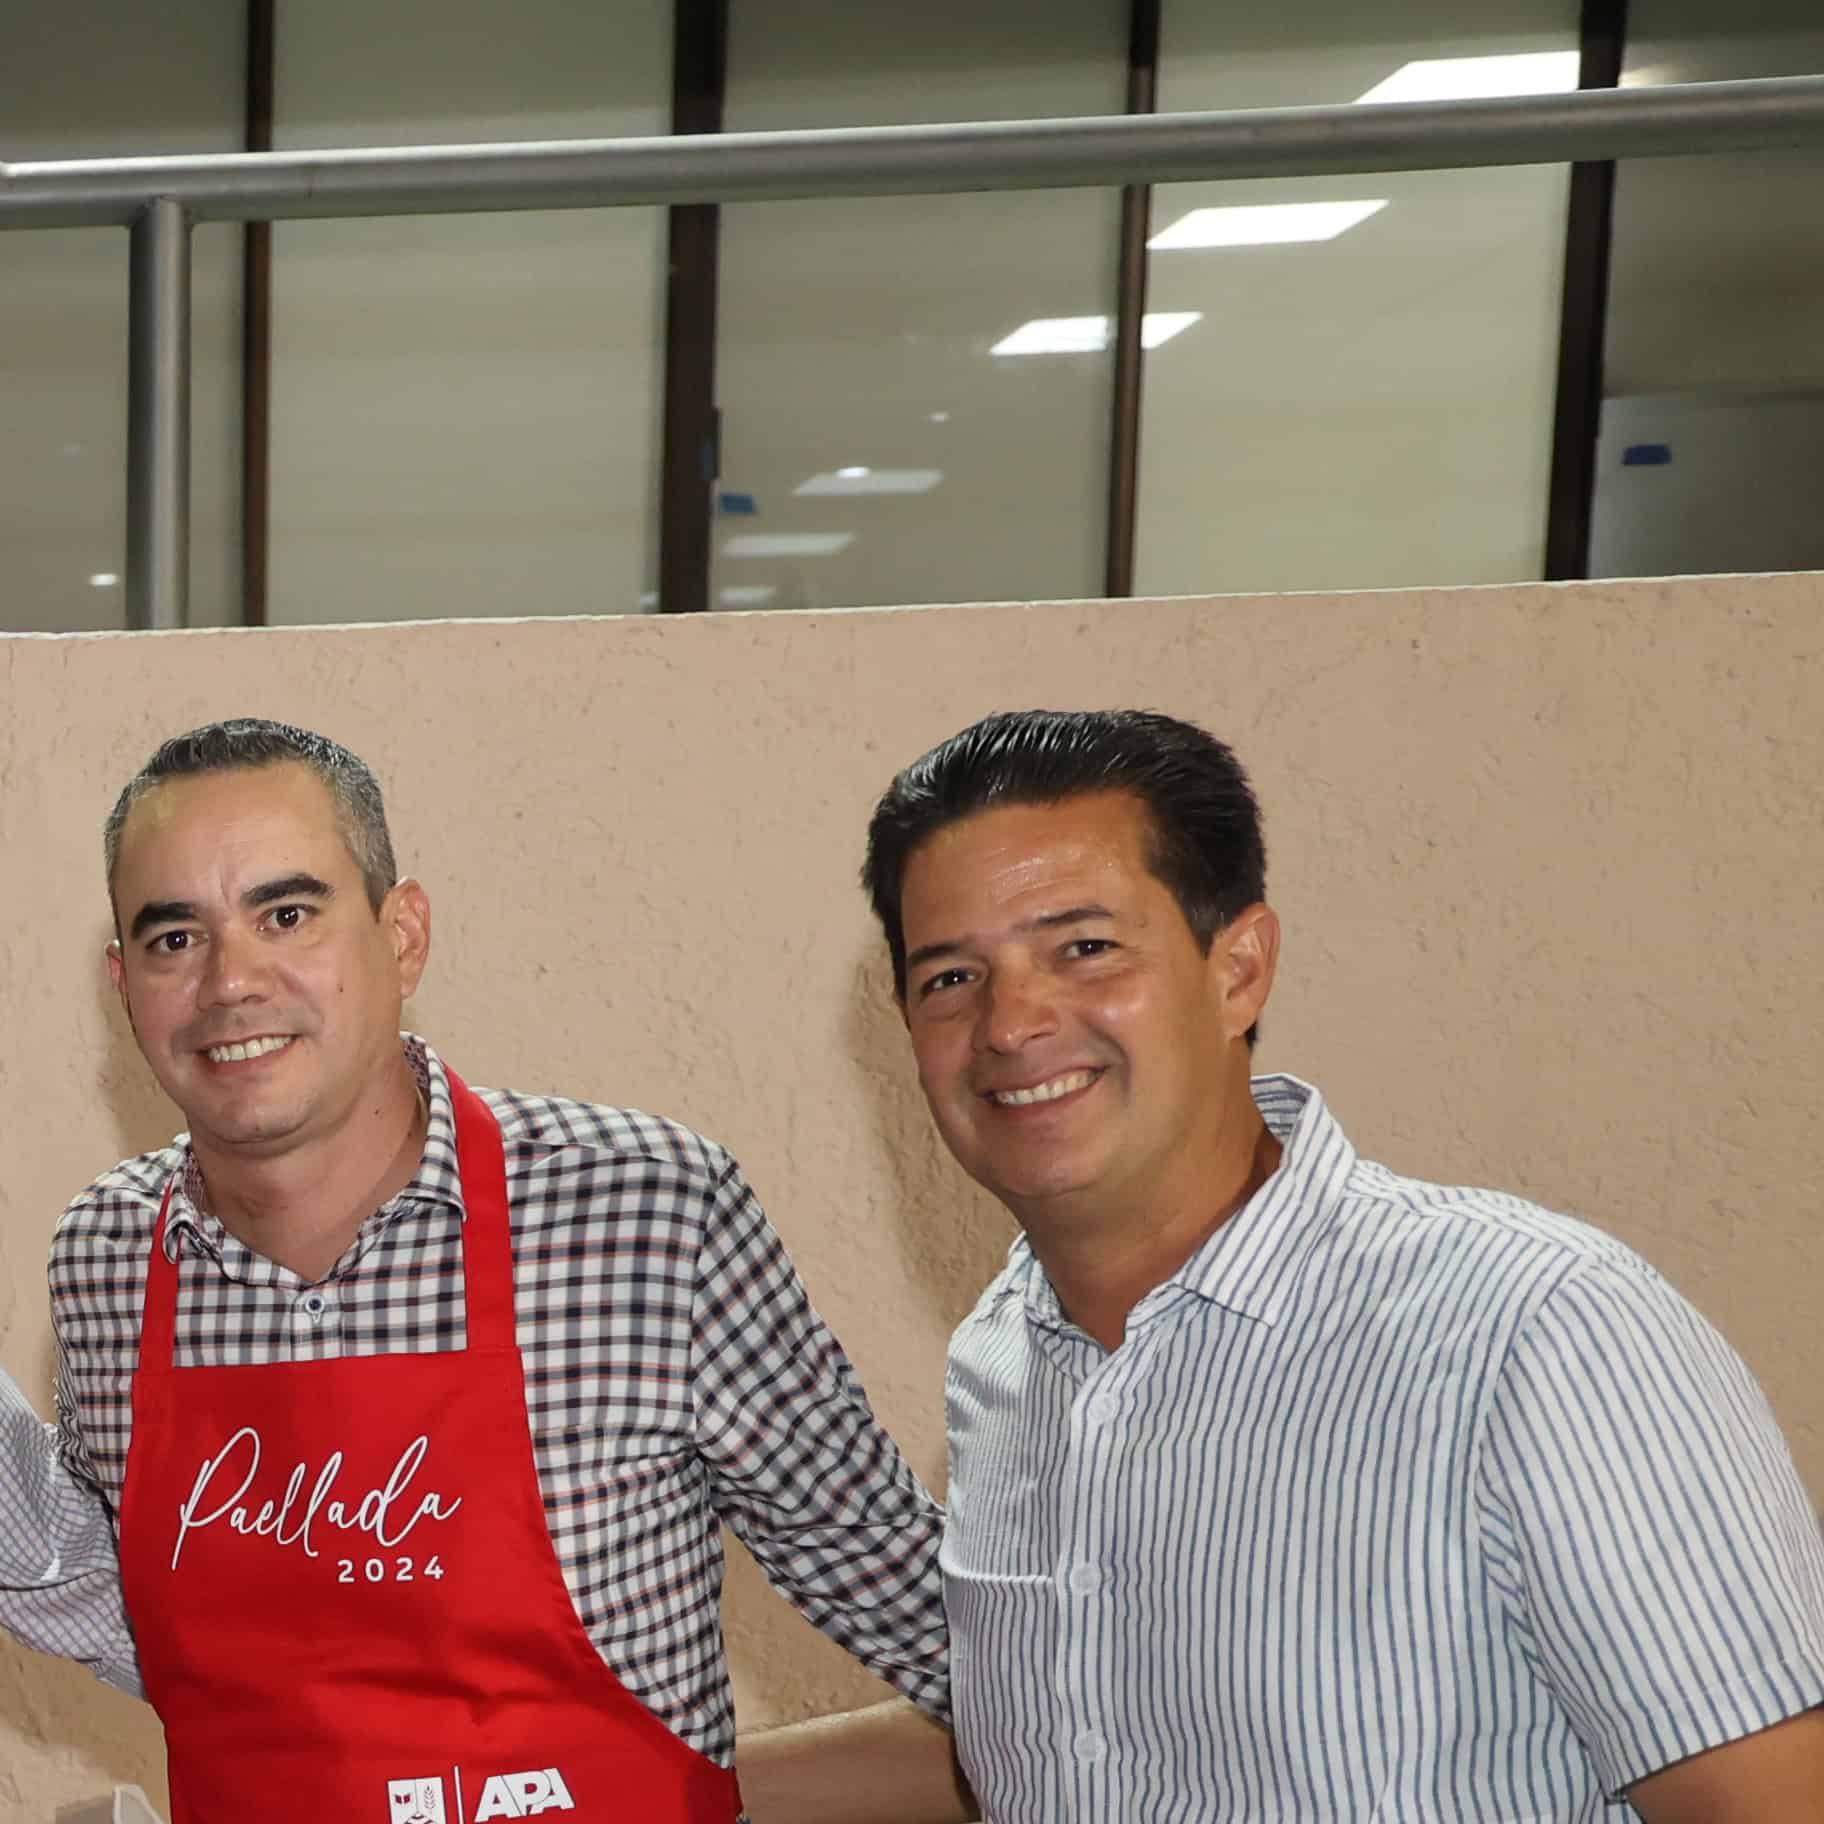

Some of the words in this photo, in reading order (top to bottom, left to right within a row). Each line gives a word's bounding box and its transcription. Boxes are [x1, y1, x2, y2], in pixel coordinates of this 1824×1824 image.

[172, 1428, 461, 1571] Paellada
[338, 1556, 443, 1582] 2024
[475, 1768, 574, 1822] APA
